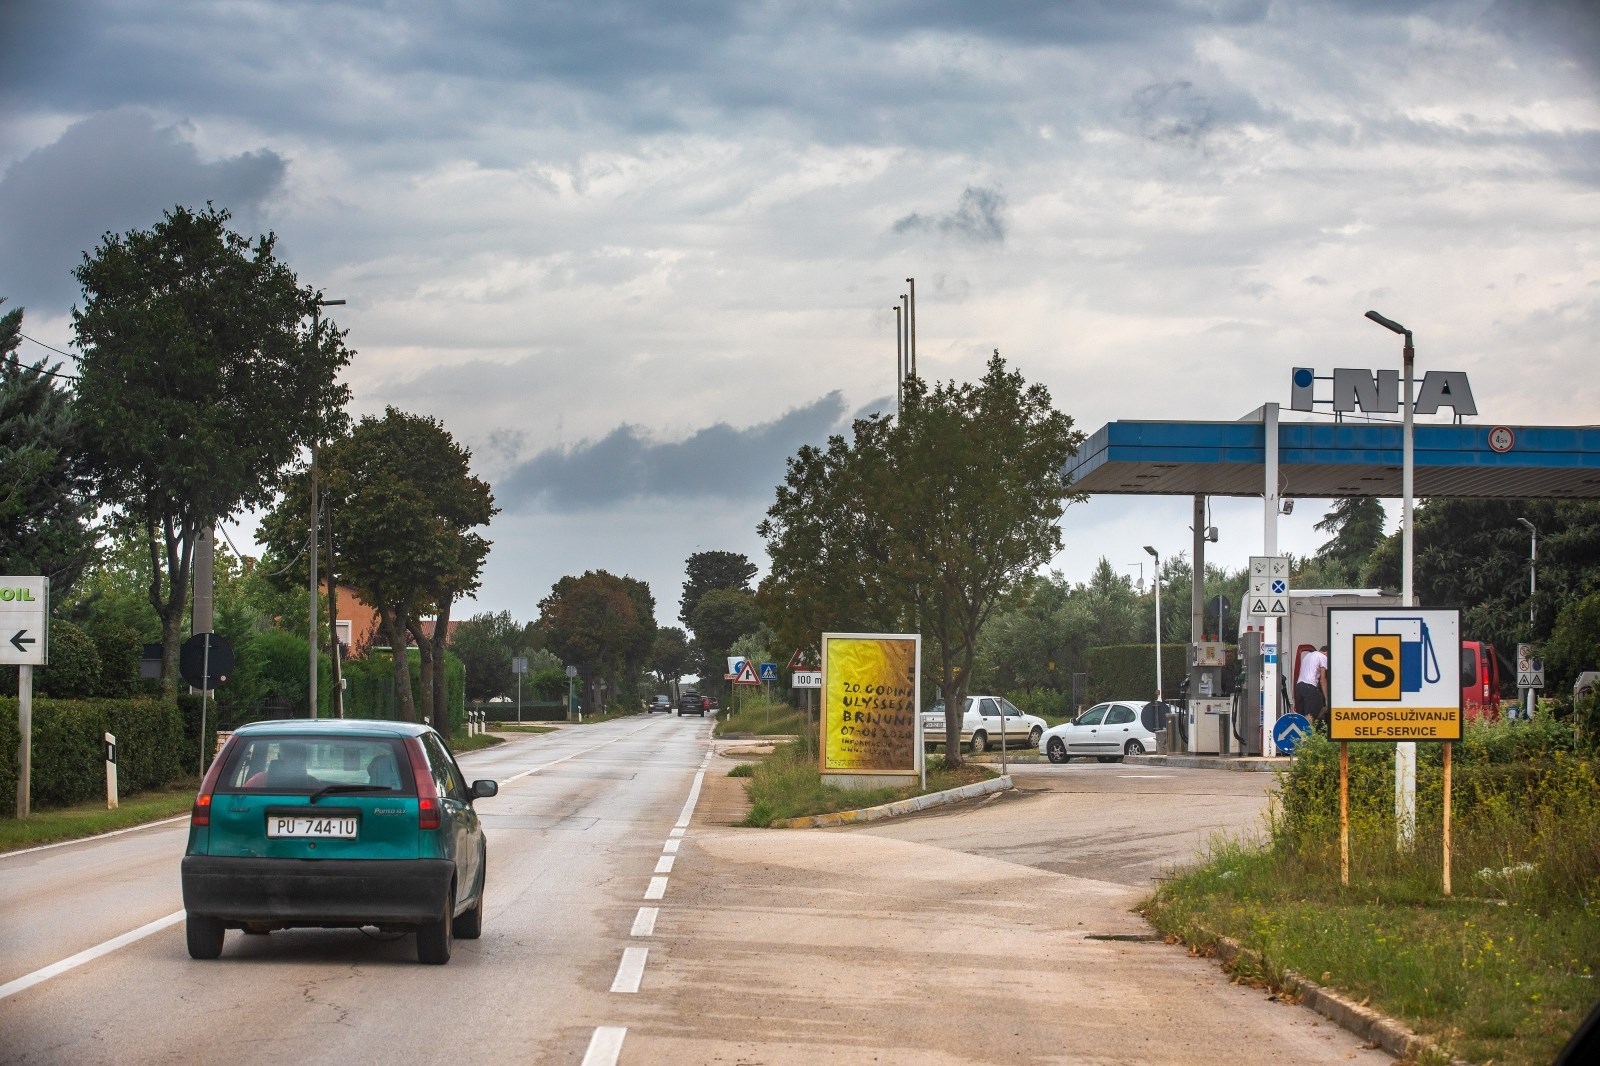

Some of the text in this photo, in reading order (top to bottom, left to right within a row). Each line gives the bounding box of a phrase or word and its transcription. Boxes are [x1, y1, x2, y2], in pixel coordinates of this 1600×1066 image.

[0, 587, 35, 601] OIL
[1362, 647, 1395, 689] S
[797, 676, 811, 684] 100
[843, 682, 914, 697] 20. GODINA
[843, 696, 914, 712] ULYSSESA
[843, 710, 913, 726] BRIJUNI
[1335, 709, 1456, 721] SAMOPOSLUŽIVANJE
[882, 729, 913, 739] 2020
[1354, 727, 1436, 736] SELF-SERVICE
[277, 820, 354, 834] PU 744-IU
